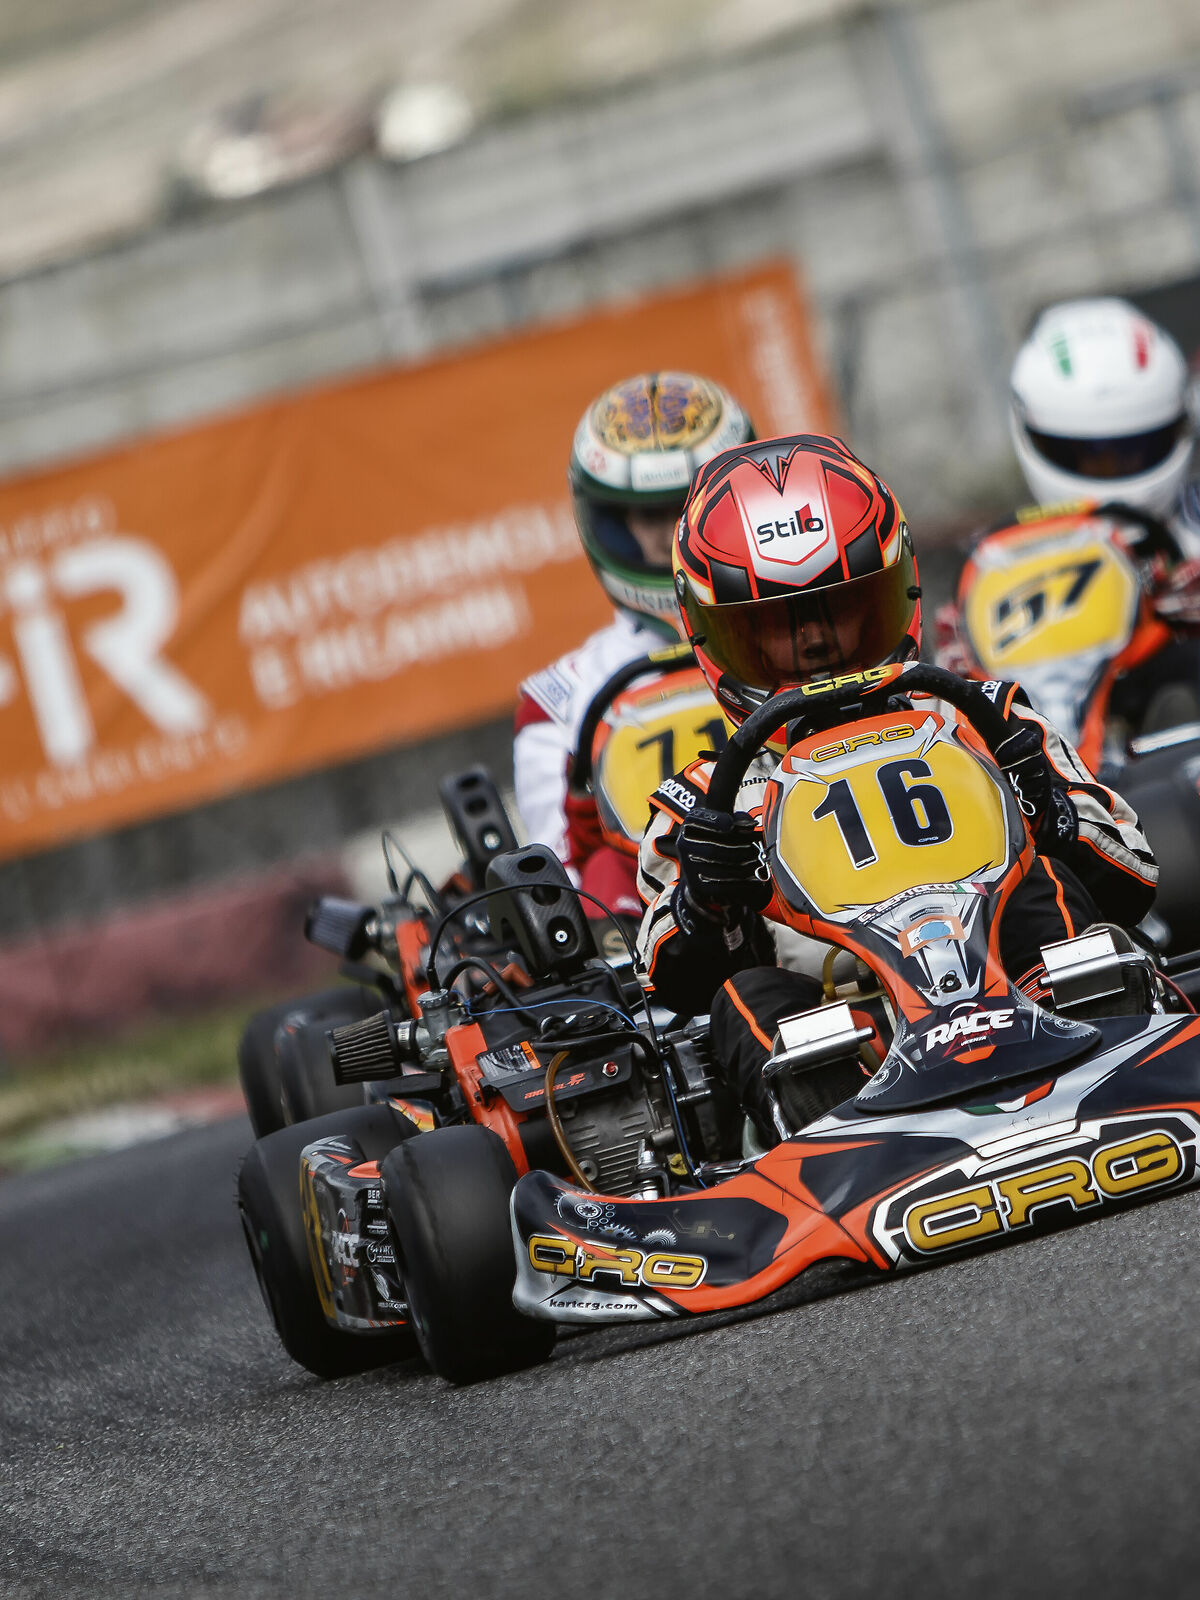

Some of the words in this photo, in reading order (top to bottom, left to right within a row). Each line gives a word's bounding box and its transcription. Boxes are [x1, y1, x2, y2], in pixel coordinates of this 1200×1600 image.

[756, 503, 824, 544] Stilo
[996, 558, 1104, 650] 57
[801, 664, 894, 696] CRG
[635, 717, 731, 785] 71
[810, 724, 915, 763] CRG
[812, 757, 954, 871] 16
[874, 883, 958, 914] BERTOCCO
[920, 1008, 1016, 1052] RACE
[902, 1130, 1187, 1256] CRG
[528, 1233, 709, 1291] CRG
[549, 1298, 639, 1311] kartcrg.com
